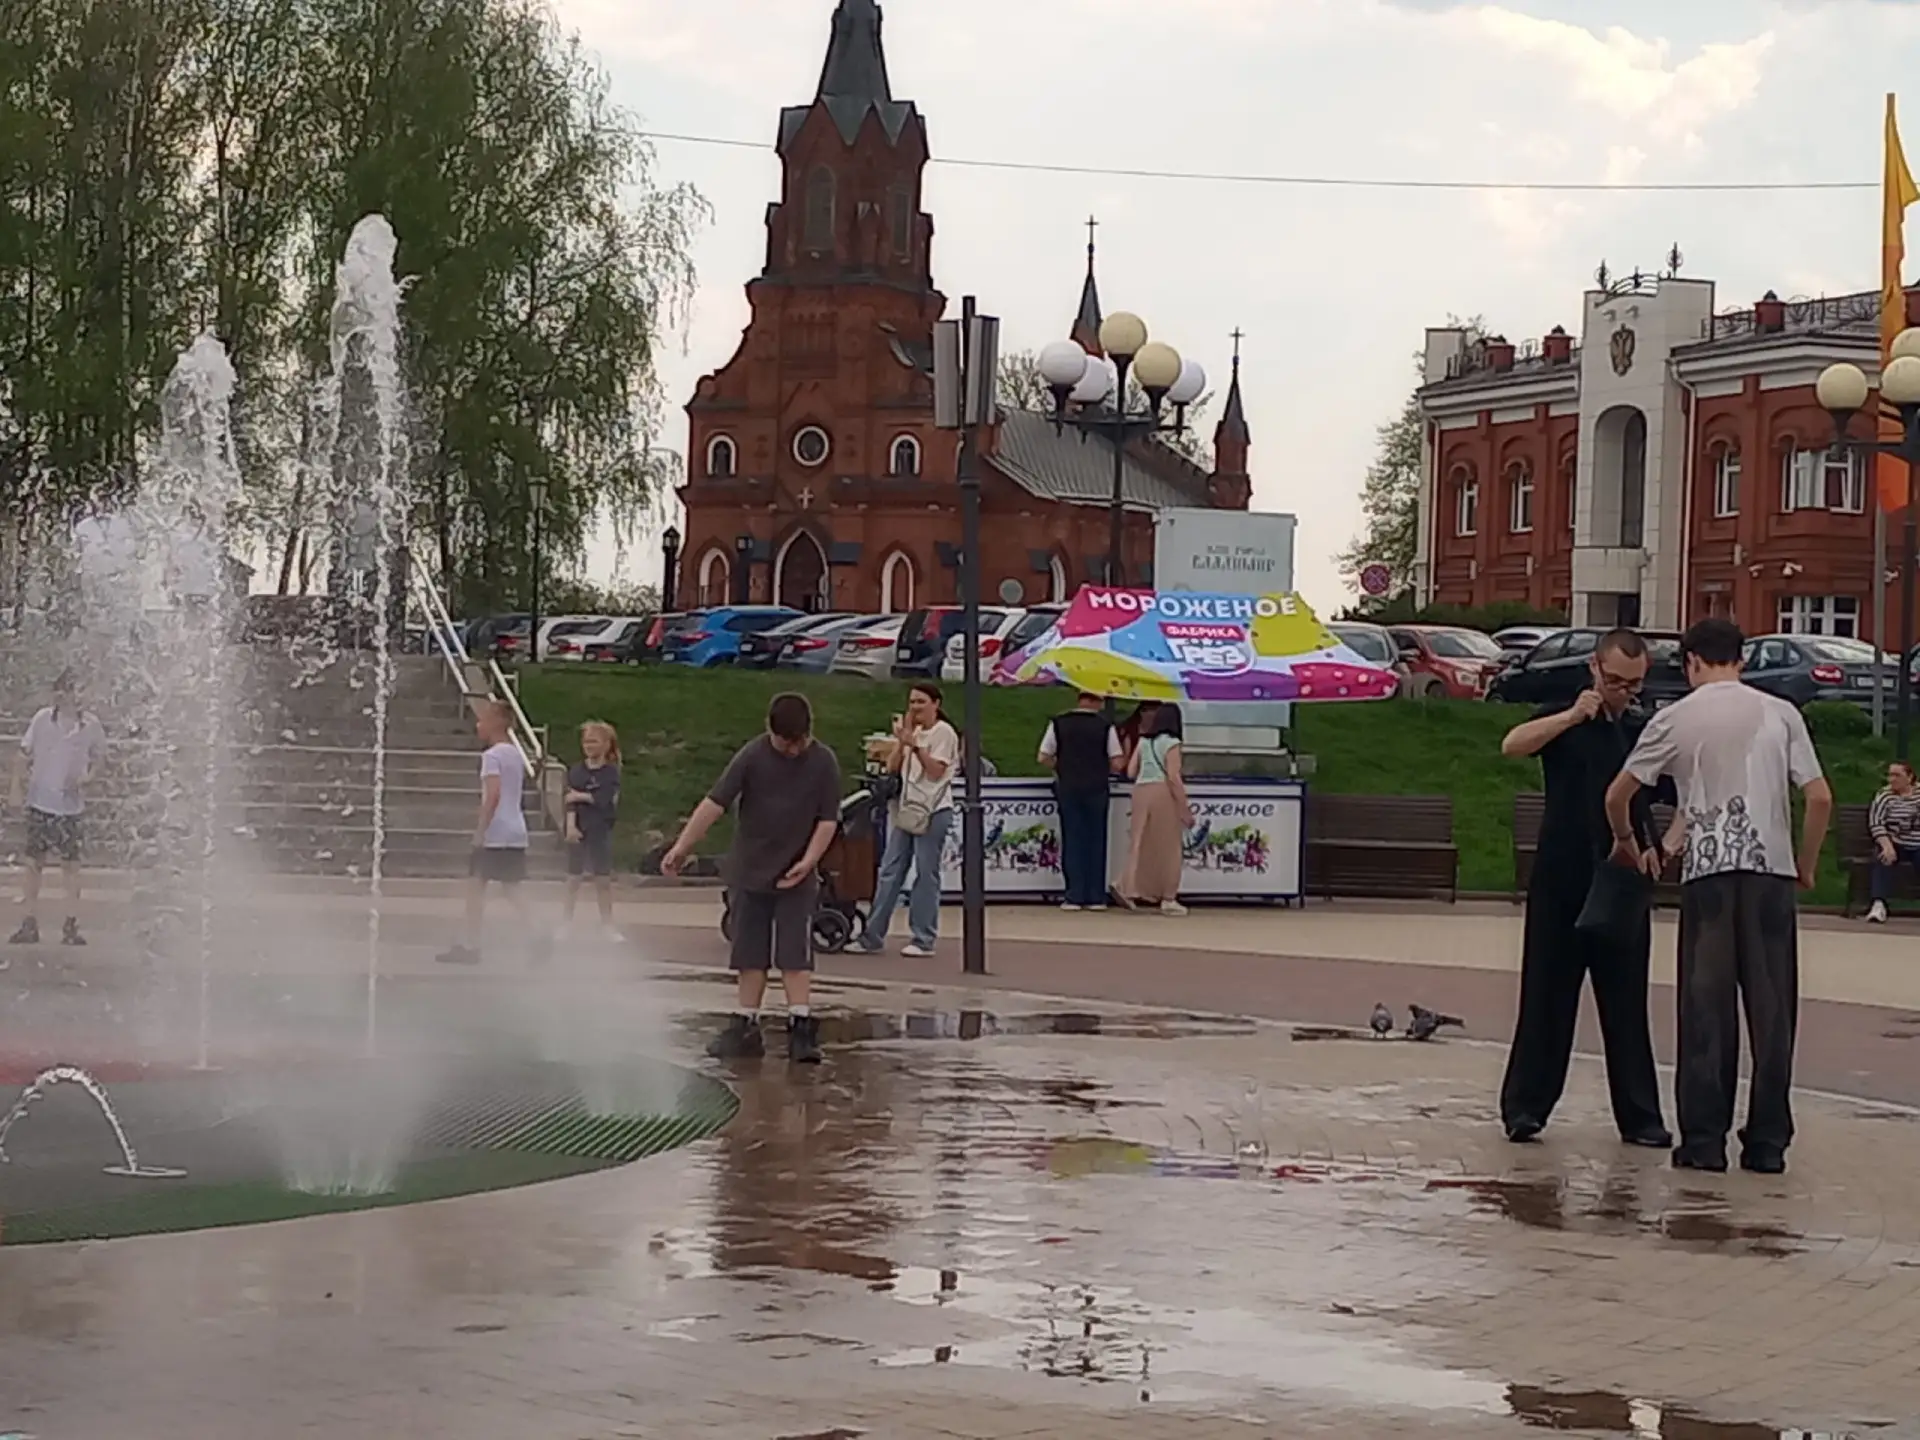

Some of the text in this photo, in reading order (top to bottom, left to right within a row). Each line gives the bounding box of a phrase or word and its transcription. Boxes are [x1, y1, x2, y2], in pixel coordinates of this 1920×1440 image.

[1087, 591, 1298, 618] МОРОЖЕНОЕ
[1165, 625, 1240, 638] ФАБРИКА
[1188, 802, 1275, 817] оженое
